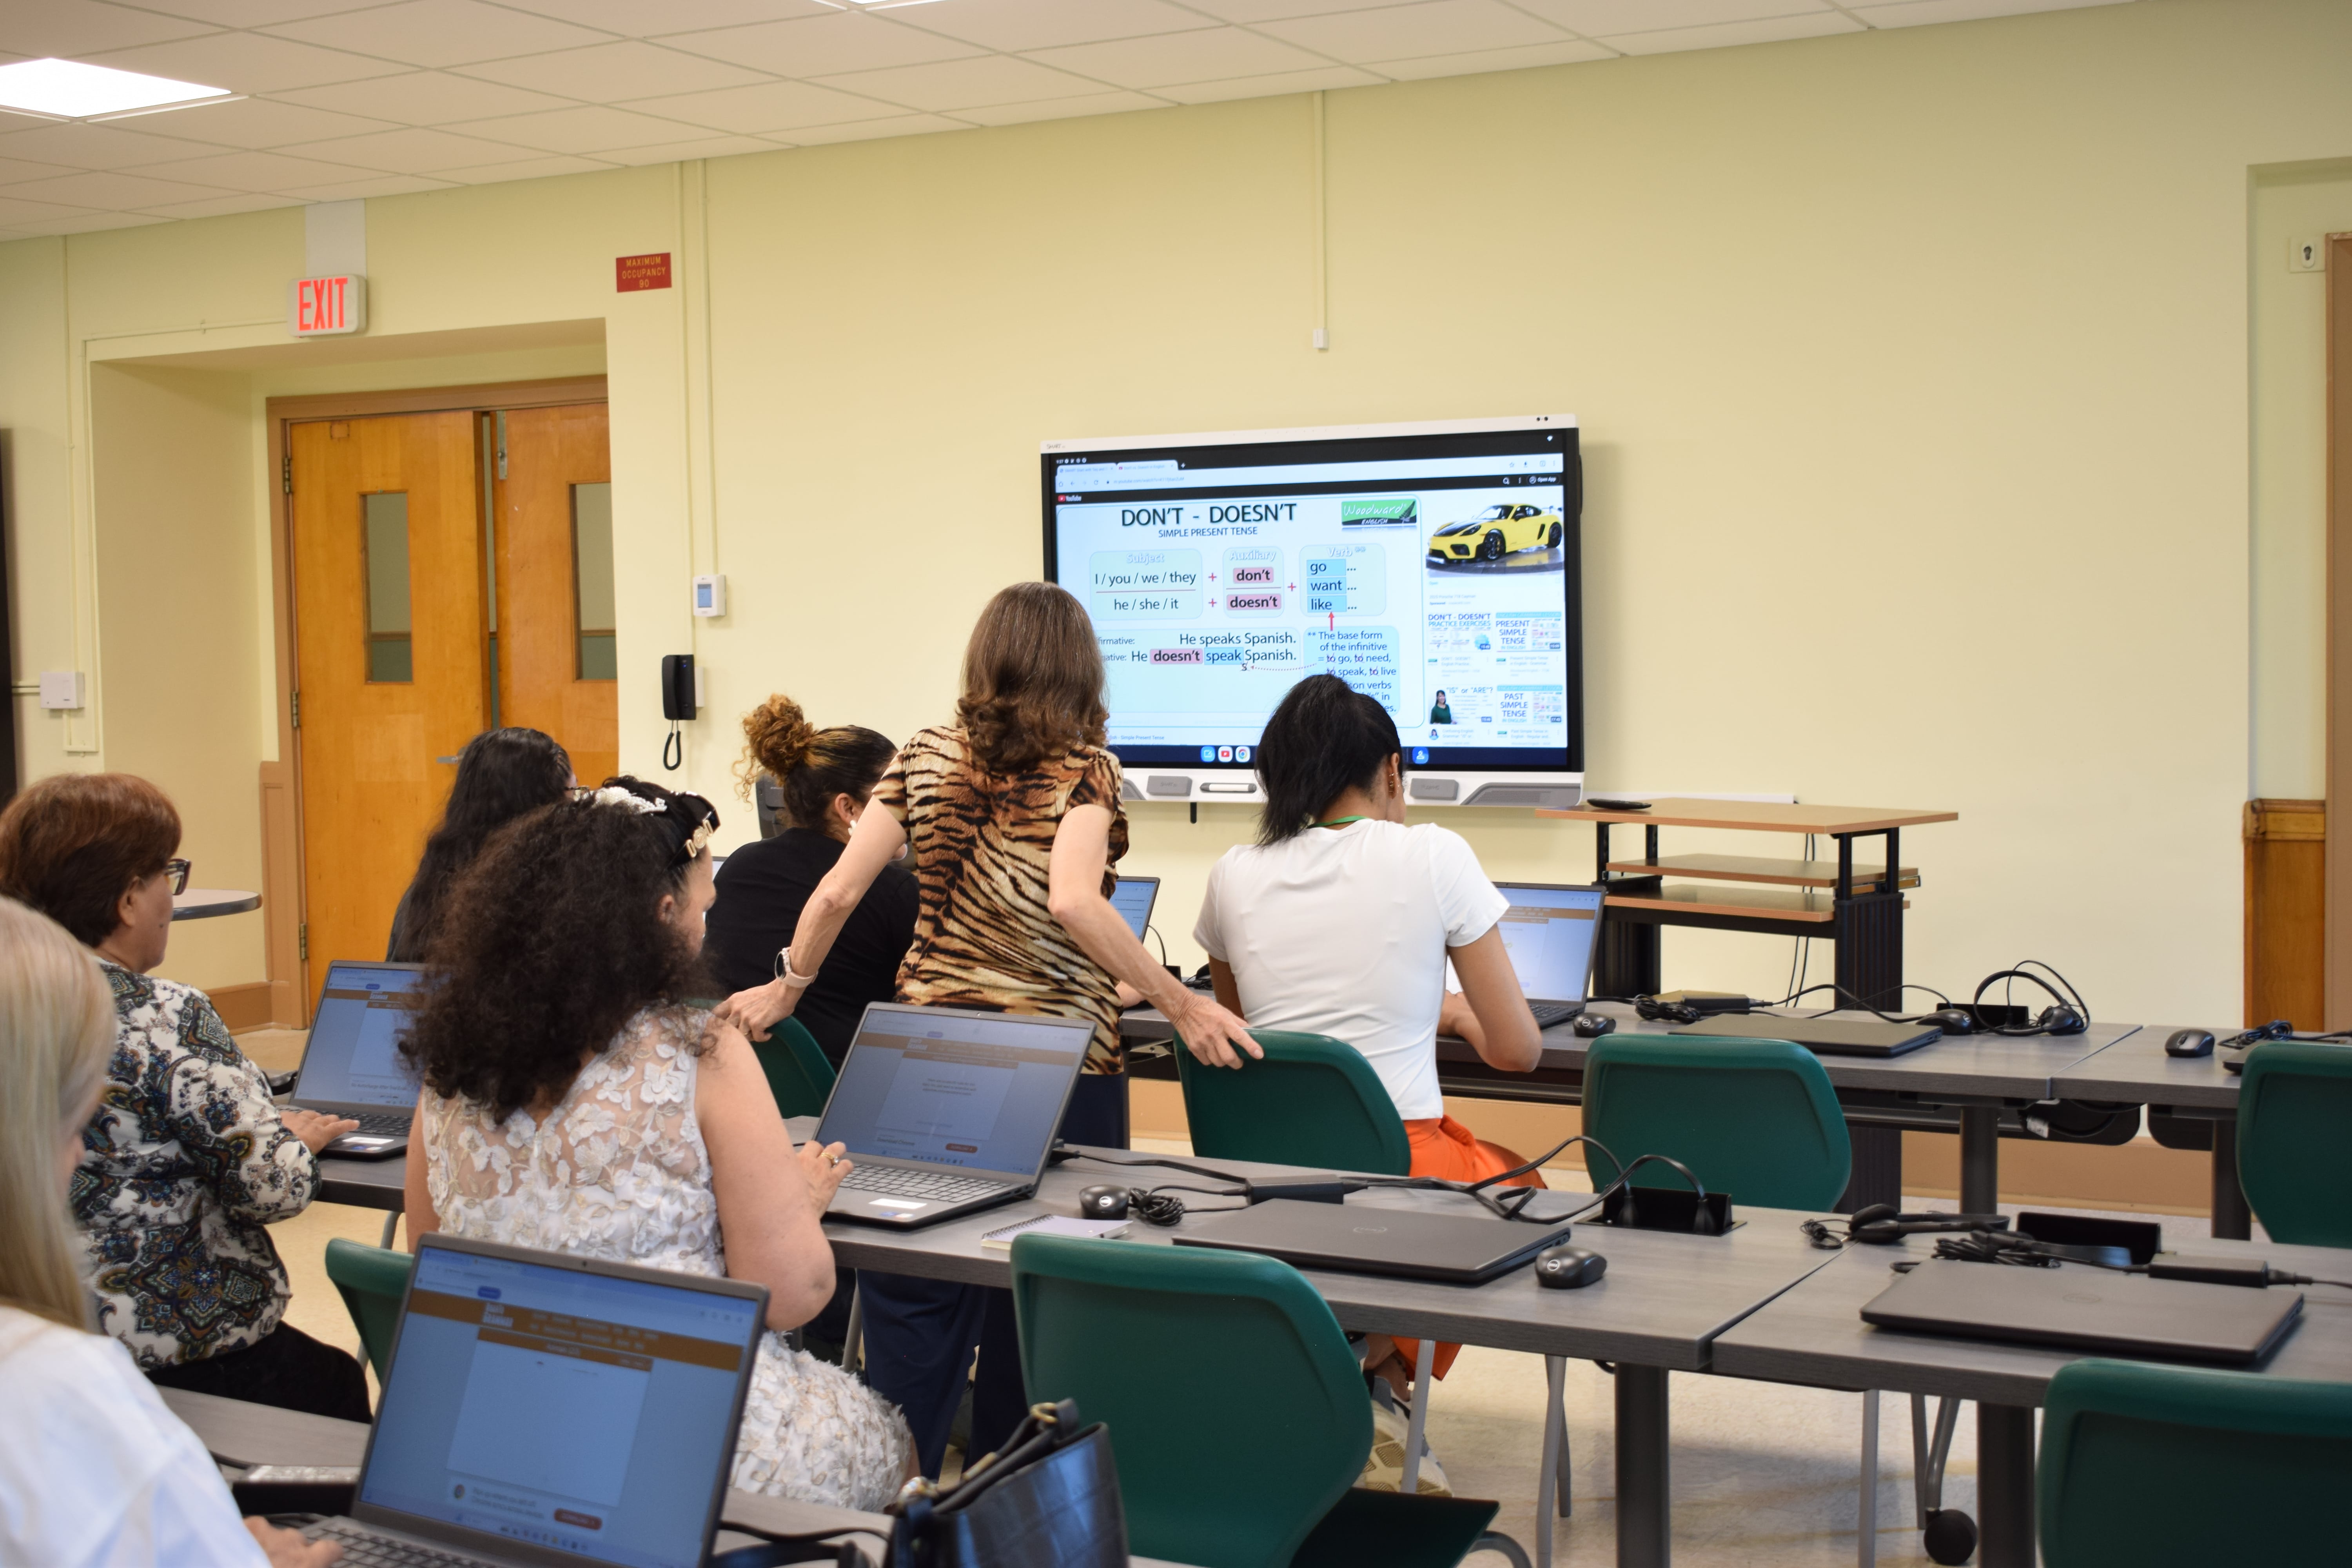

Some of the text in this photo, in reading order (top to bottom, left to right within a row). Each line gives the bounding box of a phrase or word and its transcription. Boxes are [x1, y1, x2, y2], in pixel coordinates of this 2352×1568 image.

[626, 256, 661, 267] MAXIMUM
[622, 267, 666, 279] OCCUPANCY
[639, 279, 649, 288] 90
[298, 277, 348, 331] EXIT
[1122, 508, 1183, 526] DON'T
[1210, 504, 1296, 523] DOESN'T
[1158, 527, 1258, 537] SIMPLE PRESENT TENSE
[1229, 550, 1276, 562] Auxiliary
[1327, 547, 1352, 557] Verb
[1126, 553, 1165, 565] Subject
[1310, 563, 1327, 575] go
[1095, 573, 1098, 584] I
[1109, 575, 1131, 587] you
[1141, 574, 1159, 583] we
[1169, 571, 1196, 585] they
[1236, 569, 1270, 580] don't
[1310, 580, 1342, 591] want
[1114, 599, 1129, 610] he
[1140, 598, 1160, 610] she
[1171, 598, 1179, 609] it
[1230, 596, 1277, 608] doesn't
[1311, 598, 1332, 610] like
[1180, 633, 1196, 645] He
[1200, 633, 1241, 647] speaks
[1245, 632, 1296, 647] Spanish.
[1318, 631, 1335, 640] The
[1338, 631, 1358, 639] base
[1361, 630, 1383, 639] form
[1320, 642, 1387, 651] of the infinitive
[1132, 651, 1148, 662] He
[1154, 650, 1200, 662] doesn't
[1206, 649, 1241, 664] speak
[1245, 649, 1296, 663] Spanish.
[1327, 654, 1336, 662] to
[1338, 656, 1352, 664] go,
[1366, 653, 1391, 663] need,
[1338, 667, 1367, 677] speak,
[1381, 667, 1396, 675] live
[1367, 681, 1392, 690] verbs
[1381, 692, 1390, 701] in
